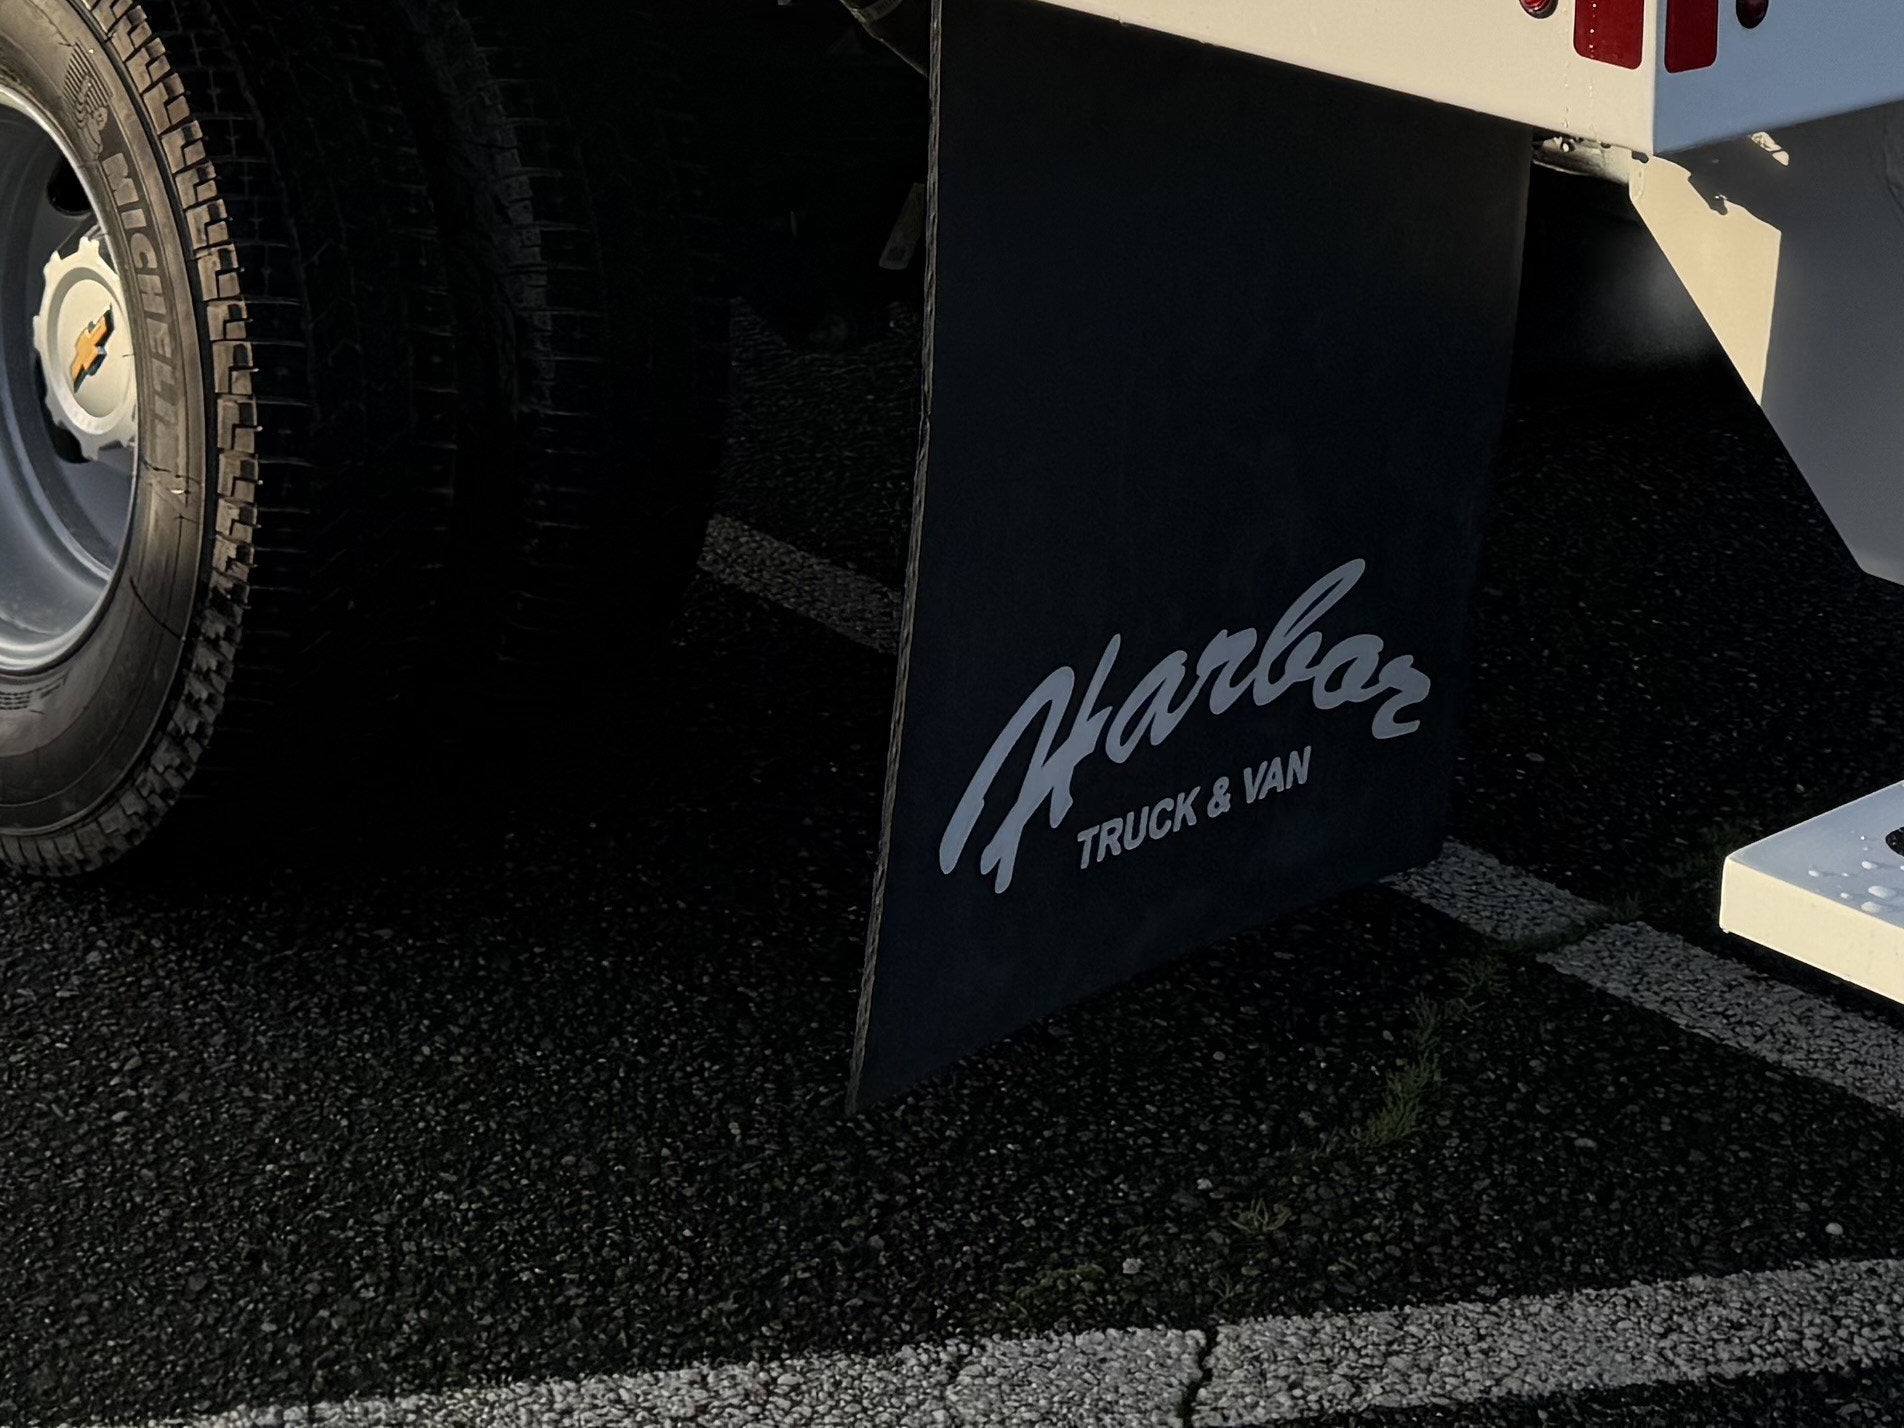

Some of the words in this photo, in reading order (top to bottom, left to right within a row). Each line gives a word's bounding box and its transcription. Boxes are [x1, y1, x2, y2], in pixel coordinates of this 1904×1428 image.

[938, 558, 1432, 895] Harbor
[1076, 787, 1201, 870] TRUCK
[1206, 777, 1232, 819] &
[1243, 746, 1312, 806] VAN
